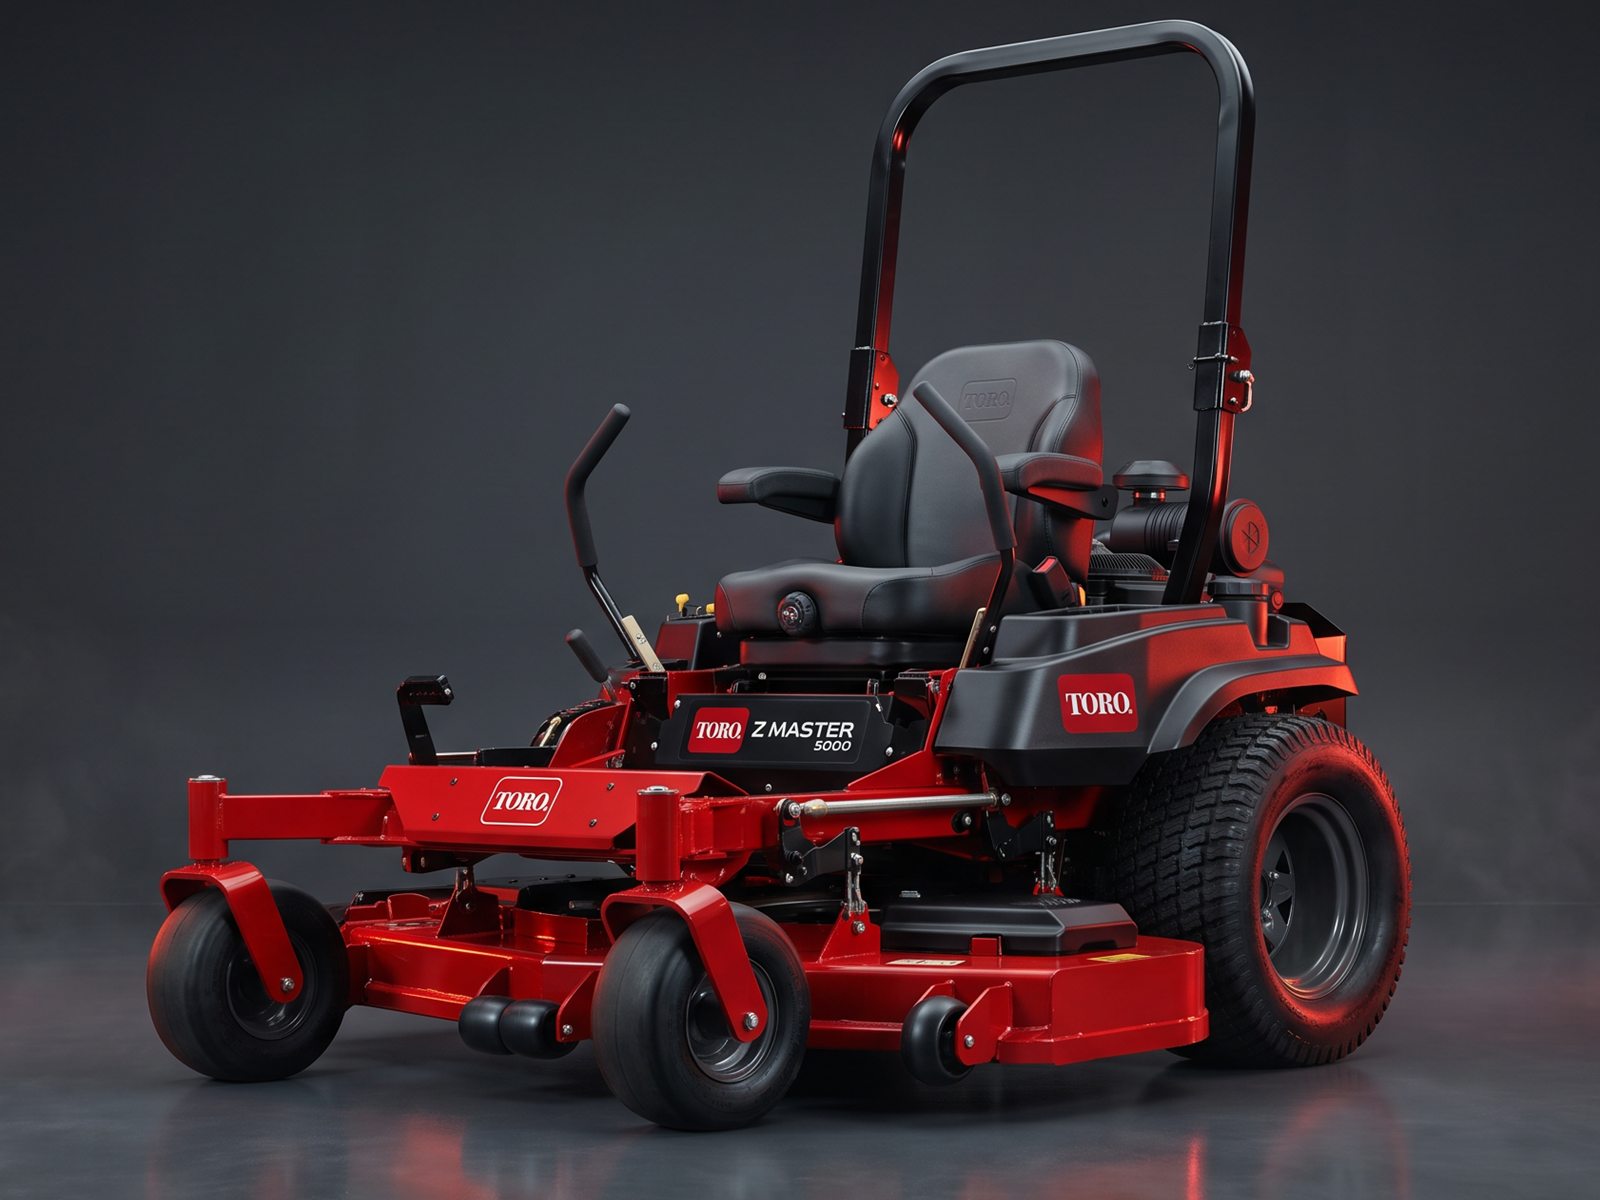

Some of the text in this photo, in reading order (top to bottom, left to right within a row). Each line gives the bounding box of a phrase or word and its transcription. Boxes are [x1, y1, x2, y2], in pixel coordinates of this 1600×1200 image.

[751, 721, 855, 738] Z MASTER
[813, 740, 852, 752] 5000
